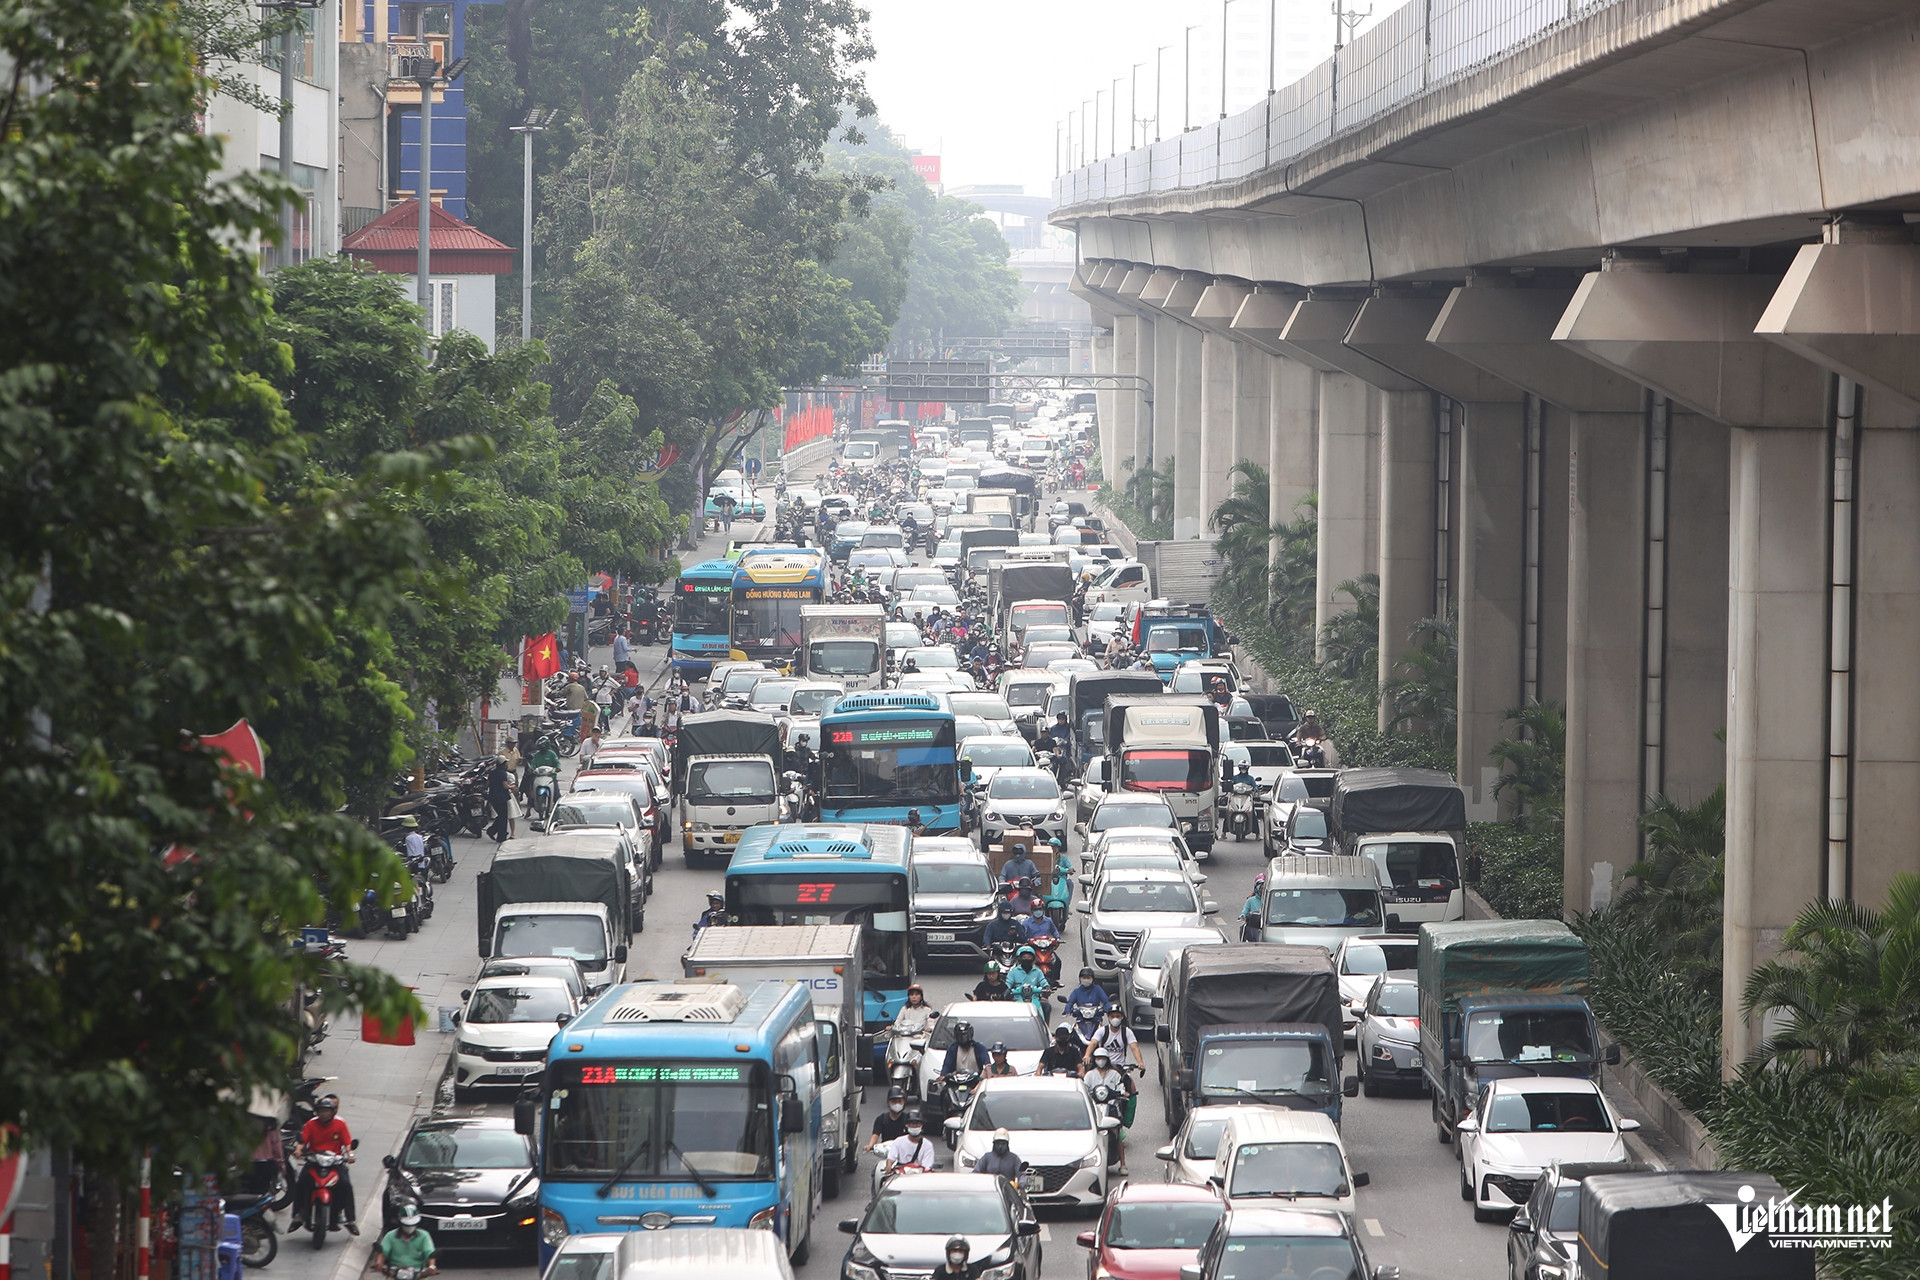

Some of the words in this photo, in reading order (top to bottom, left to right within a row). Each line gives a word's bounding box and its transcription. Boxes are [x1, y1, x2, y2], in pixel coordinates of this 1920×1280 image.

[800, 591, 812, 599] LAM
[797, 883, 836, 902] 27
[581, 1066, 617, 1084] 21A
[610, 1186, 636, 1199] BUS
